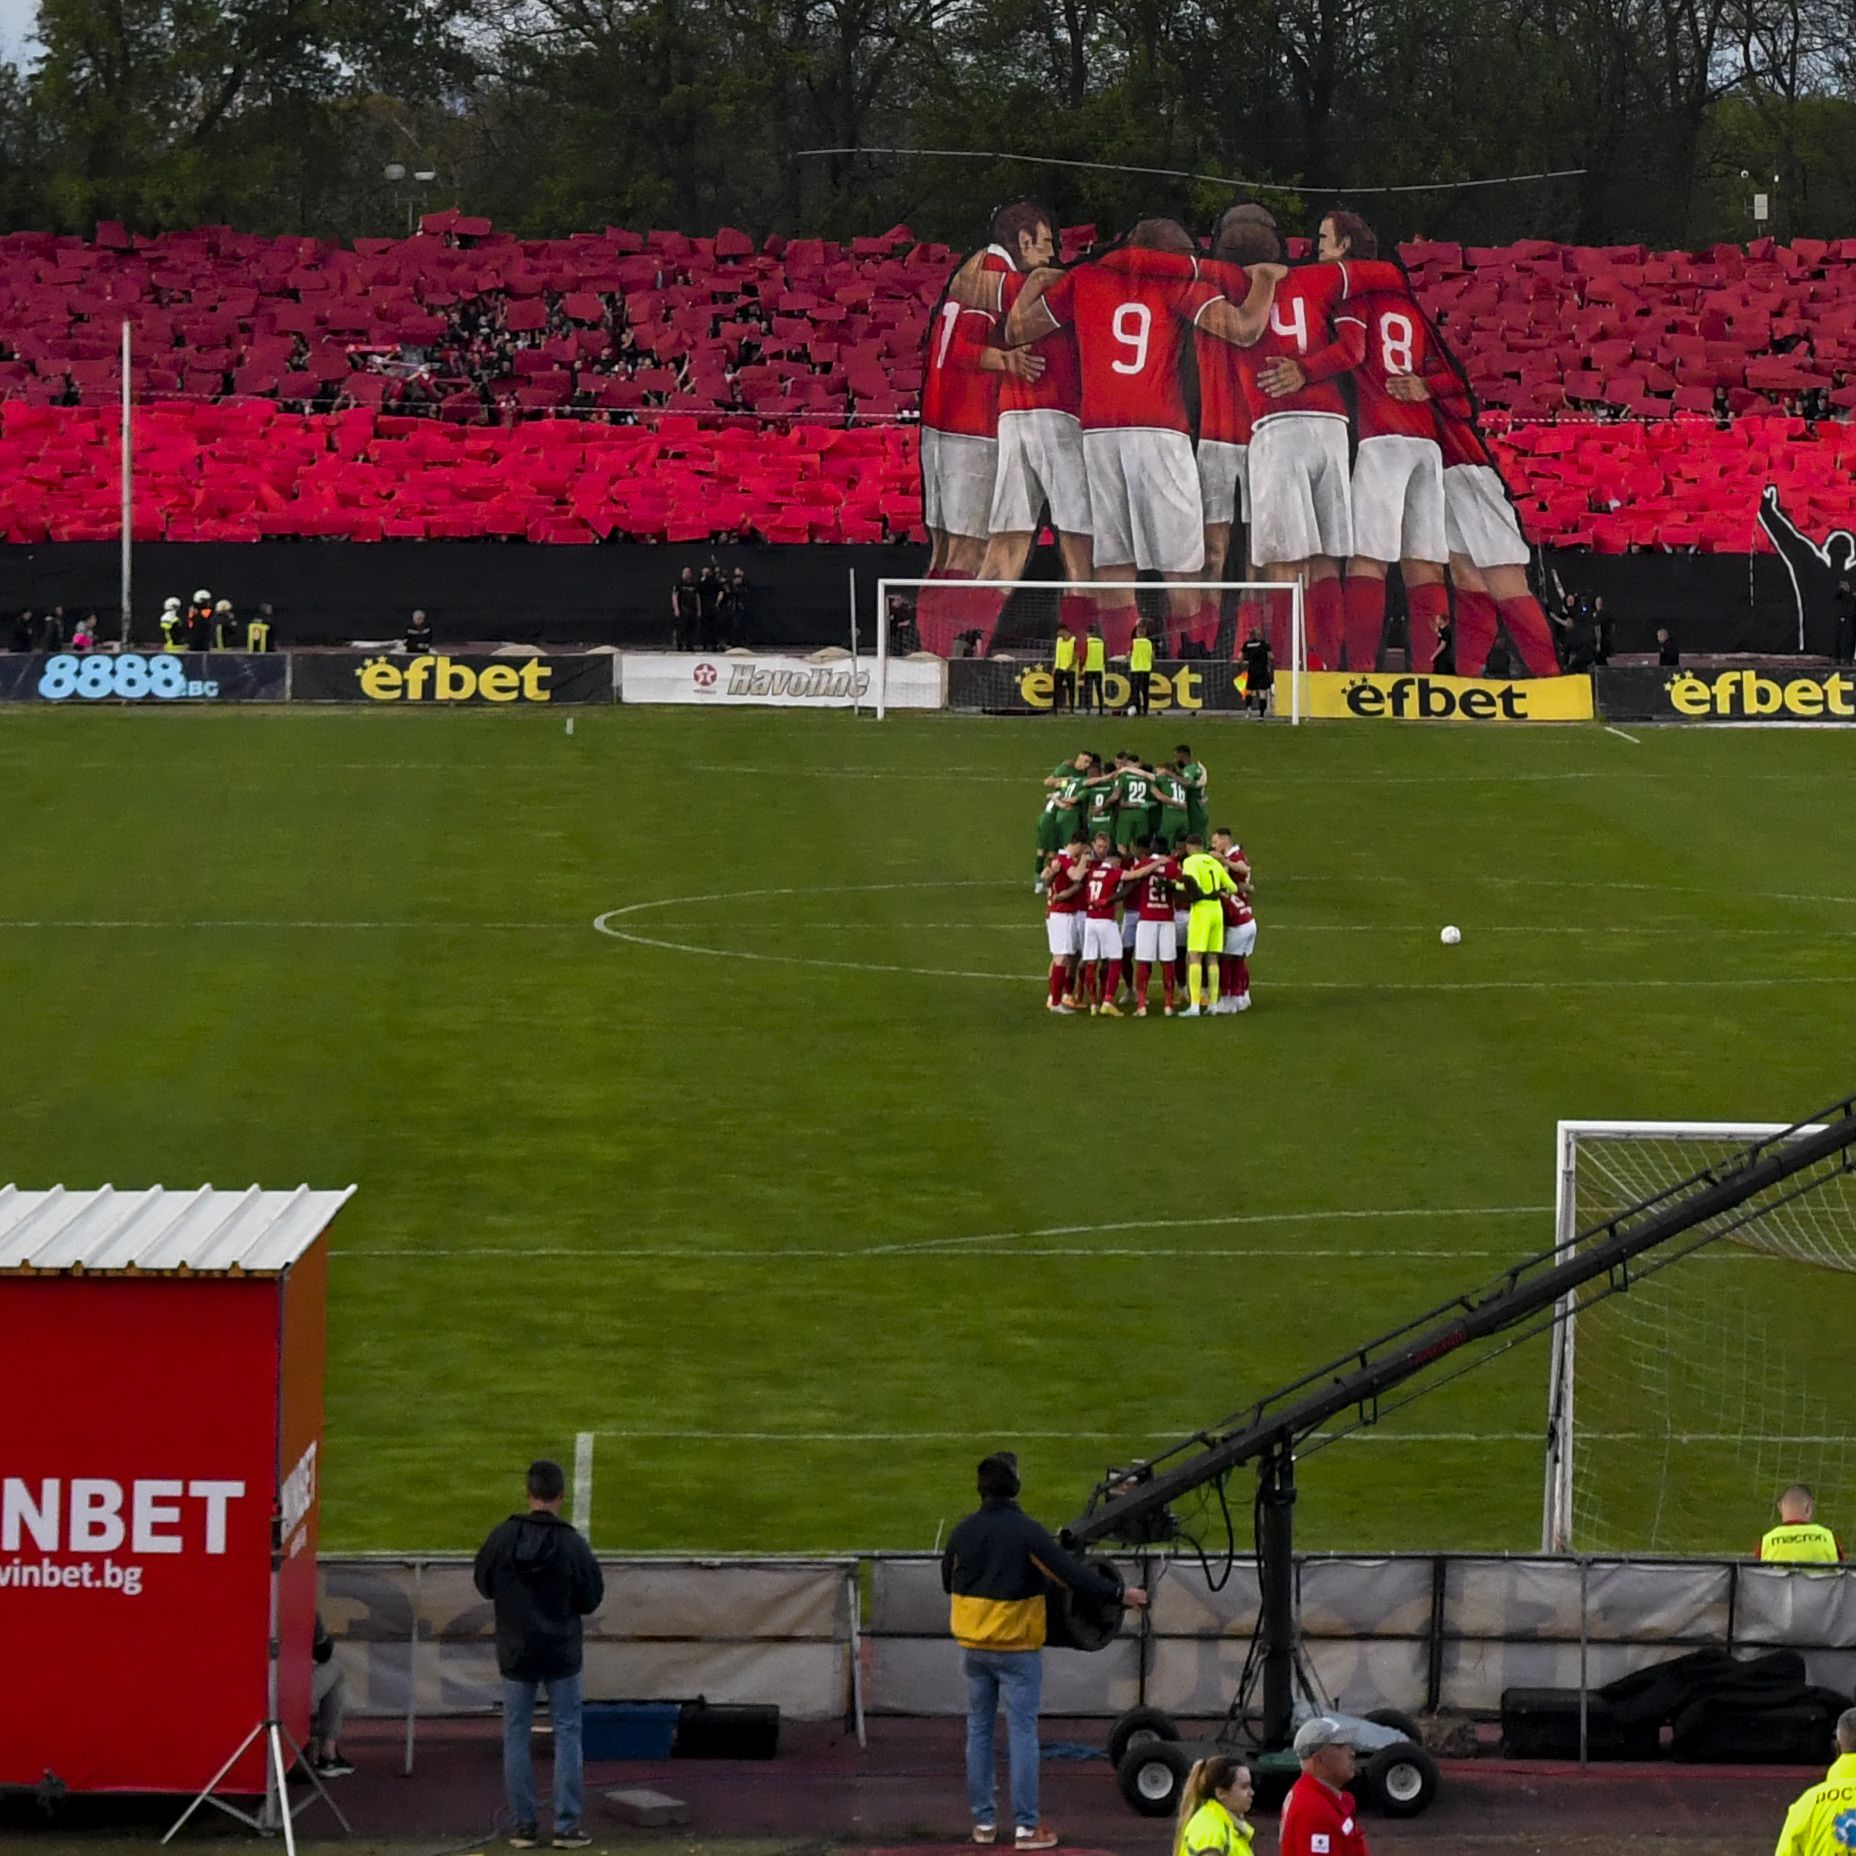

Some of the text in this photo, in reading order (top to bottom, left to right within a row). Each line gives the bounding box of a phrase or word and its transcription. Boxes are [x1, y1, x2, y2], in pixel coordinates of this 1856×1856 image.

[1111, 302, 1152, 375] 9
[1270, 296, 1307, 355] 4
[1379, 311, 1413, 375] 8
[359, 655, 552, 701] efbet
[727, 663, 871, 699] Havoline
[1347, 676, 1529, 720] efbet
[1670, 670, 1855, 716] efbet
[1128, 781, 1147, 803] 22
[1770, 1533, 1828, 1546] macron
